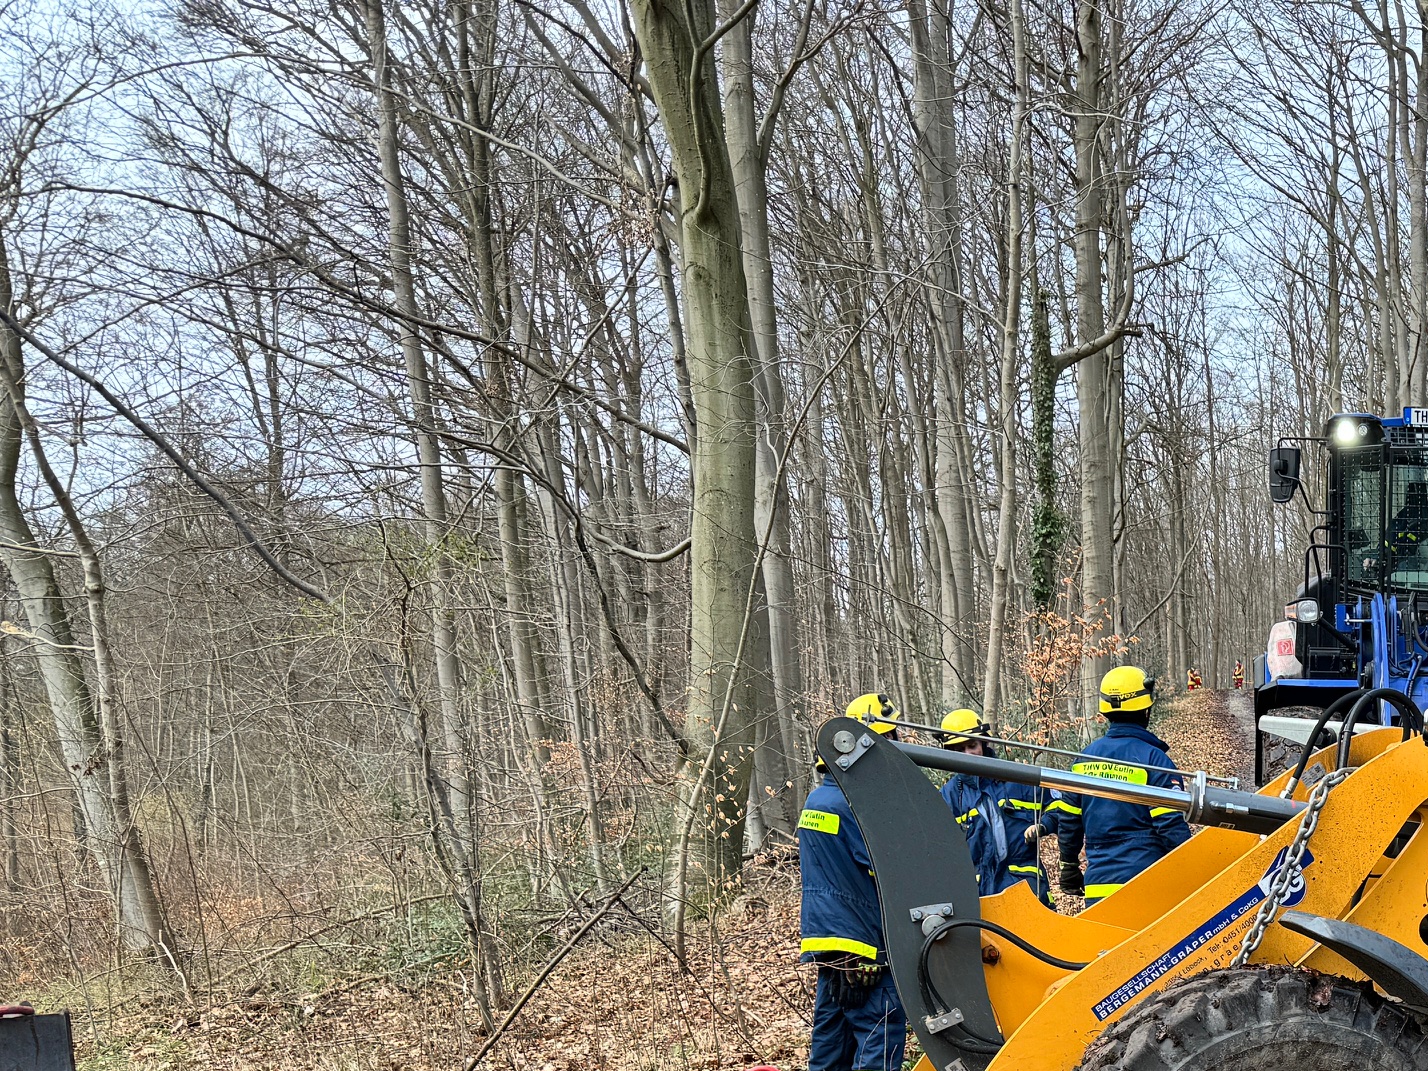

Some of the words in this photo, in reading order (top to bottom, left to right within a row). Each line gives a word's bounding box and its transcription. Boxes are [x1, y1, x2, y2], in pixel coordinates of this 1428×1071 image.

[1212, 918, 1230, 935] mbH
[1230, 912, 1239, 921] &
[1095, 952, 1171, 1012] BAUGESELLSCHAFT
